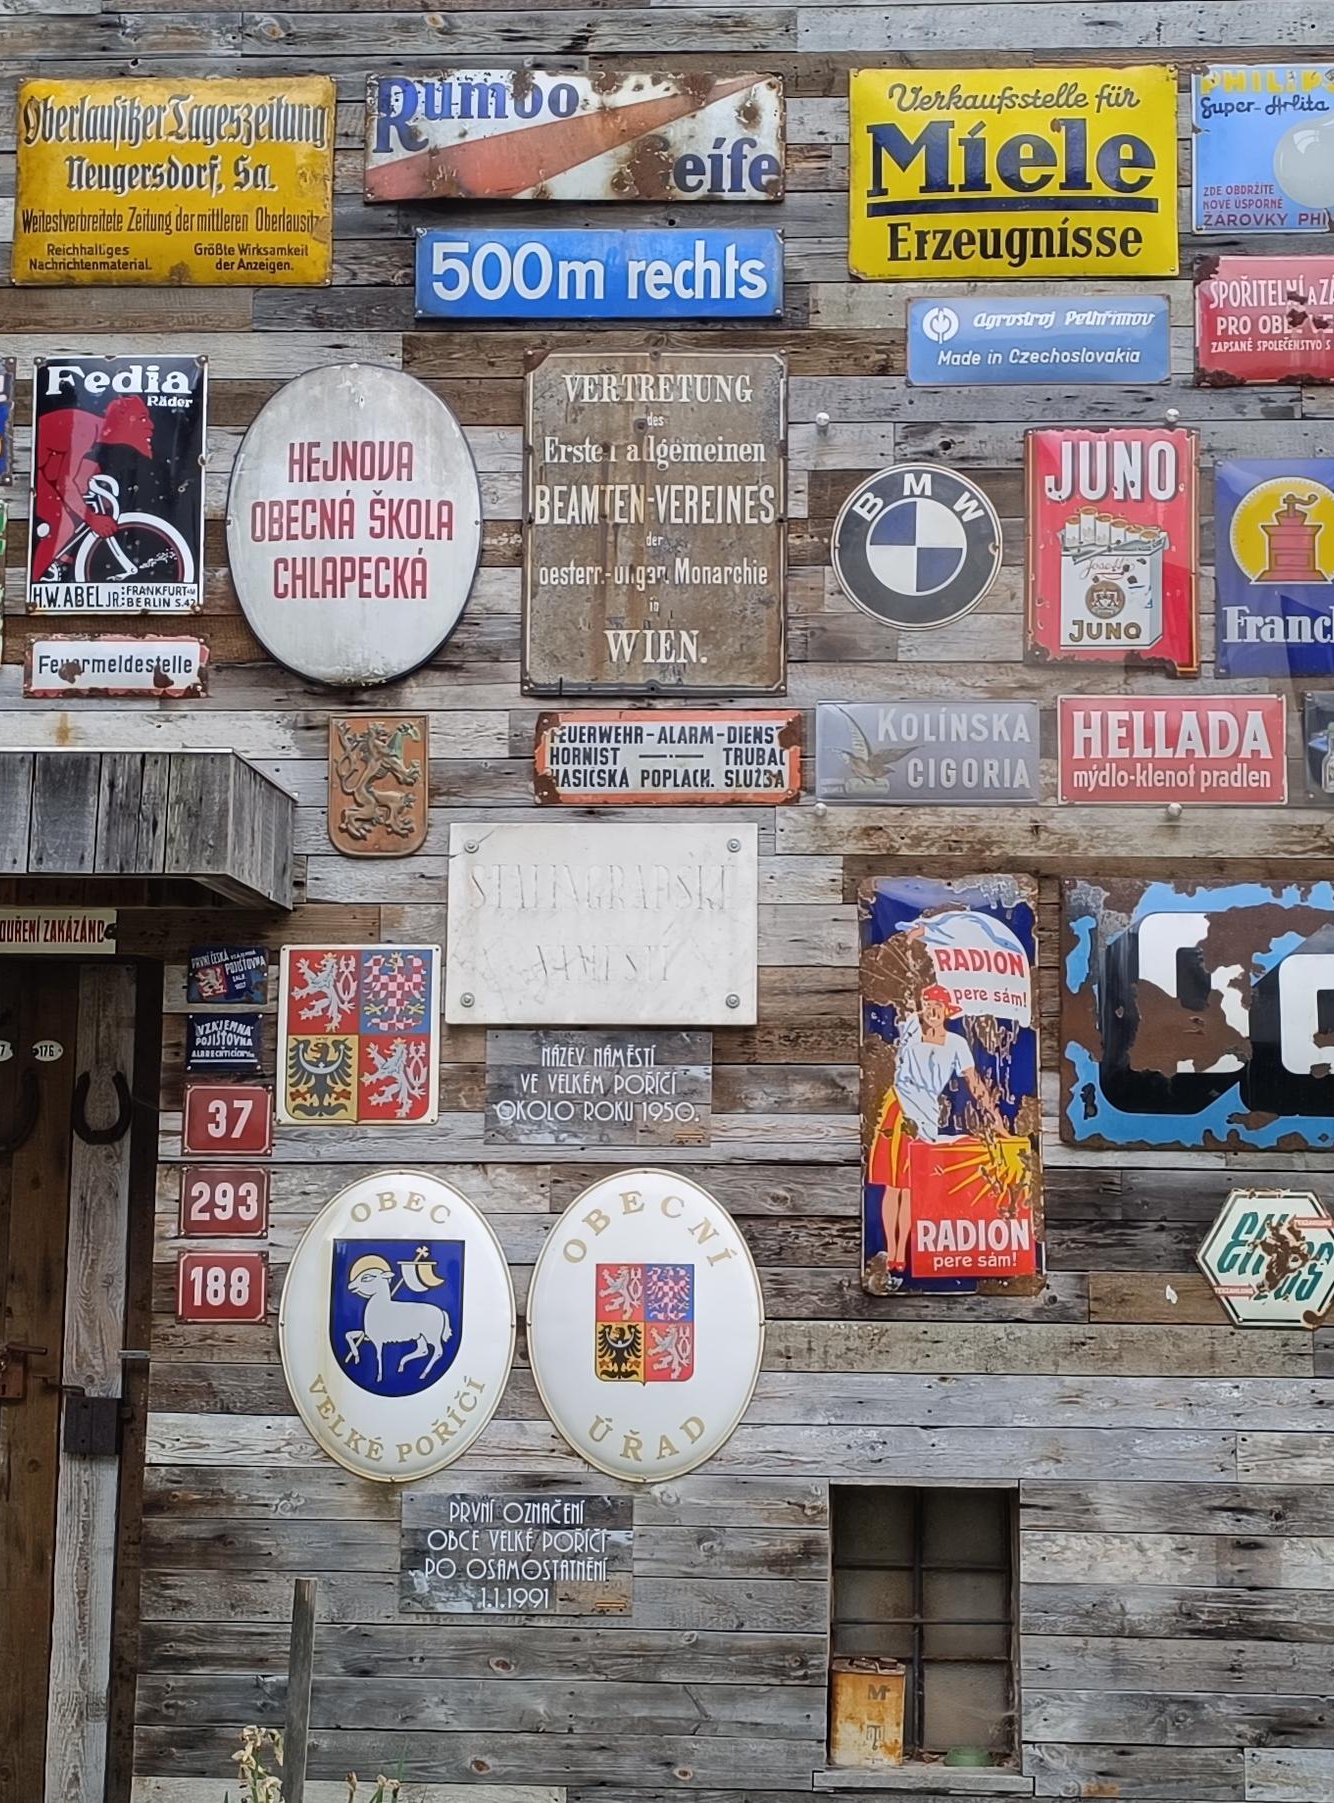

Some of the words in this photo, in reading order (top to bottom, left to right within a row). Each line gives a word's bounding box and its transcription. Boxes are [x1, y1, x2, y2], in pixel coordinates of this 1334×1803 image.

[888, 81, 1088, 114] Verkaufsstelle
[1095, 84, 1140, 113] für
[167, 93, 330, 149] Tageszeitung
[866, 118, 1156, 197] Miele
[1203, 186, 1223, 197] ZDE
[126, 207, 172, 235] Zeitung
[175, 209, 195, 232] der
[197, 209, 248, 232] mittleren
[194, 242, 235, 257] Größte
[238, 242, 309, 256] Wirksamkeit
[887, 217, 1143, 267] Erzeugnisse
[29, 258, 152, 271] Nachrichtenmaterial.
[215, 258, 235, 271] der
[237, 258, 294, 273] Anzeigen.
[432, 241, 604, 300] 500m
[628, 239, 767, 300] rechts
[1217, 317, 1251, 336] PRO
[938, 350, 981, 366] Made
[988, 349, 1002, 365] in
[1009, 347, 1141, 365] Czechoslovakia
[1211, 337, 1253, 353] ZAPSANÉ
[46, 365, 192, 395] Fedia
[562, 374, 754, 403] VERTRETUNG
[147, 396, 193, 409] Räder
[647, 411, 665, 427] des
[289, 440, 413, 483] HEJNOVA
[1044, 439, 1178, 502] JUNO
[534, 484, 775, 526] BEAMTEN-VEREINES
[852, 473, 985, 523] BMW
[251, 489, 355, 543] OBECNÁ
[368, 489, 454, 542] ŠKOLA
[646, 532, 664, 547] der
[273, 547, 428, 600] CHLAPECKÁ
[674, 557, 769, 585] Monarchie
[126, 585, 187, 597] FRANKFURT
[126, 597, 171, 608] BERLIN
[649, 597, 660, 612] in
[1069, 619, 1142, 642] JUNO
[603, 629, 708, 664] WIEN.
[878, 706, 1032, 743] KOLÍNSKA
[1072, 709, 1274, 760] HELLADA
[550, 747, 621, 766] HORNIST
[907, 755, 1032, 790] CIGORIA
[1073, 766, 1196, 791] mýdlo-klenot
[1200, 767, 1271, 790] pradlen
[934, 949, 1025, 978] RADION
[953, 988, 988, 1002] pere
[994, 987, 1028, 1008] sám!
[39, 1045, 54, 1057] 176
[541, 1044, 586, 1068] NÁZEV
[593, 1044, 657, 1069] NÁMĚSTÍ
[521, 1074, 538, 1094] VE
[548, 1070, 605, 1095] VELKÉM
[614, 1071, 677, 1096] POŘÍČÍ
[207, 1100, 254, 1139] 37
[496, 1100, 575, 1122] OKOLO
[584, 1101, 634, 1122] ROKU
[642, 1101, 700, 1123] 1950.
[191, 1182, 259, 1222] 293
[350, 1188, 453, 1226] OBEC
[562, 1189, 736, 1268] OBECNÍ
[917, 1218, 1030, 1252] RADION
[934, 1256, 972, 1271] pere
[977, 1251, 1017, 1268] sám!
[190, 1267, 252, 1307] 188
[309, 1374, 386, 1463] VELKÉ
[397, 1374, 488, 1465] POŘÍČÍ
[587, 1413, 708, 1463] ÚŘAD
[449, 1498, 495, 1524] PRVNÍ
[503, 1499, 586, 1525] OZNAČENÍ
[427, 1529, 480, 1551] OBCE
[489, 1528, 534, 1553] VELKÉ
[542, 1528, 608, 1553] POŘÍČÍ
[425, 1558, 457, 1580] PO
[467, 1556, 609, 1582] OSAMOSTATNĚNÍ
[481, 1587, 549, 1609] 1.1.1991
